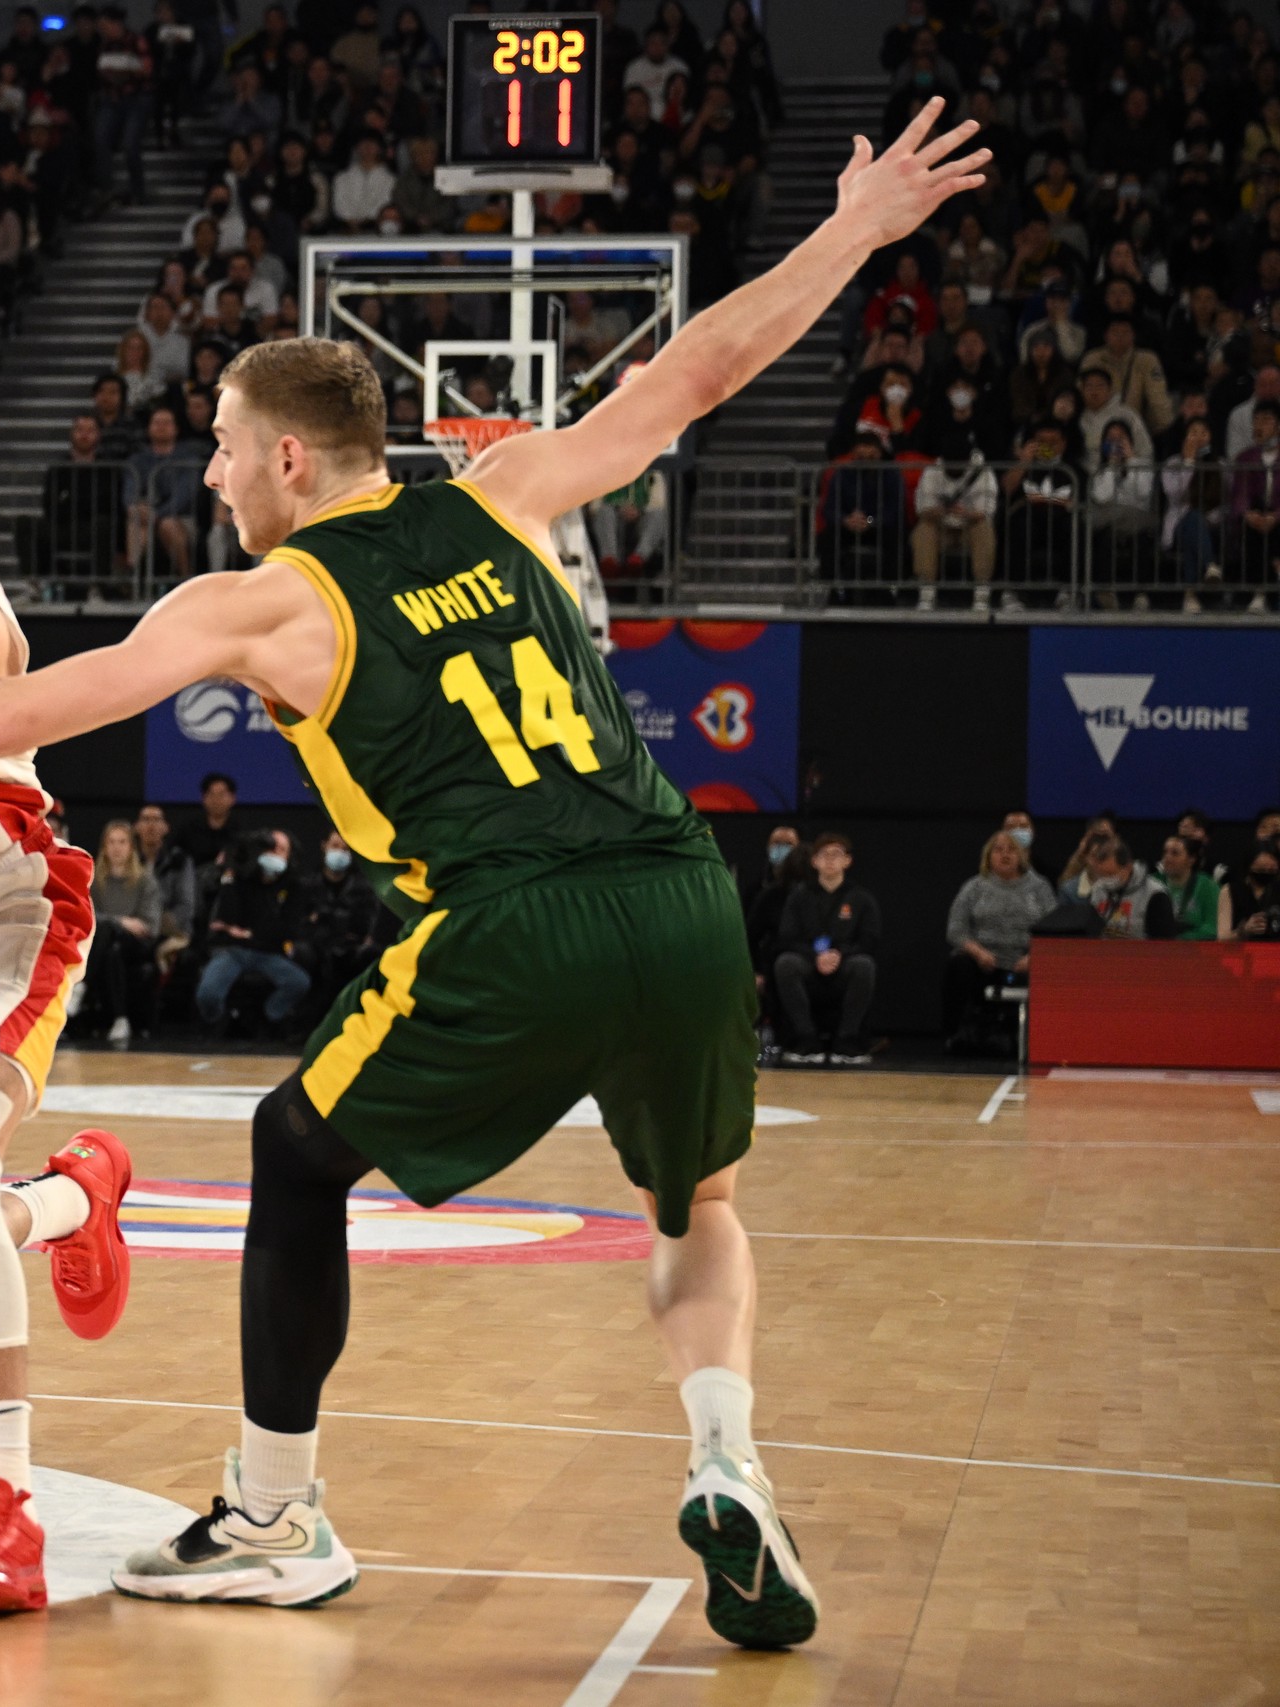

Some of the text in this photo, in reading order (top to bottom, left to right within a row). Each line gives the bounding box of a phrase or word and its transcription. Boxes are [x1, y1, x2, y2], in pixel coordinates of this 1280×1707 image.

[493, 30, 585, 74] 2:02
[392, 559, 516, 636] WHITE
[440, 635, 601, 788] 14
[1081, 705, 1249, 731] MELBOURNE
